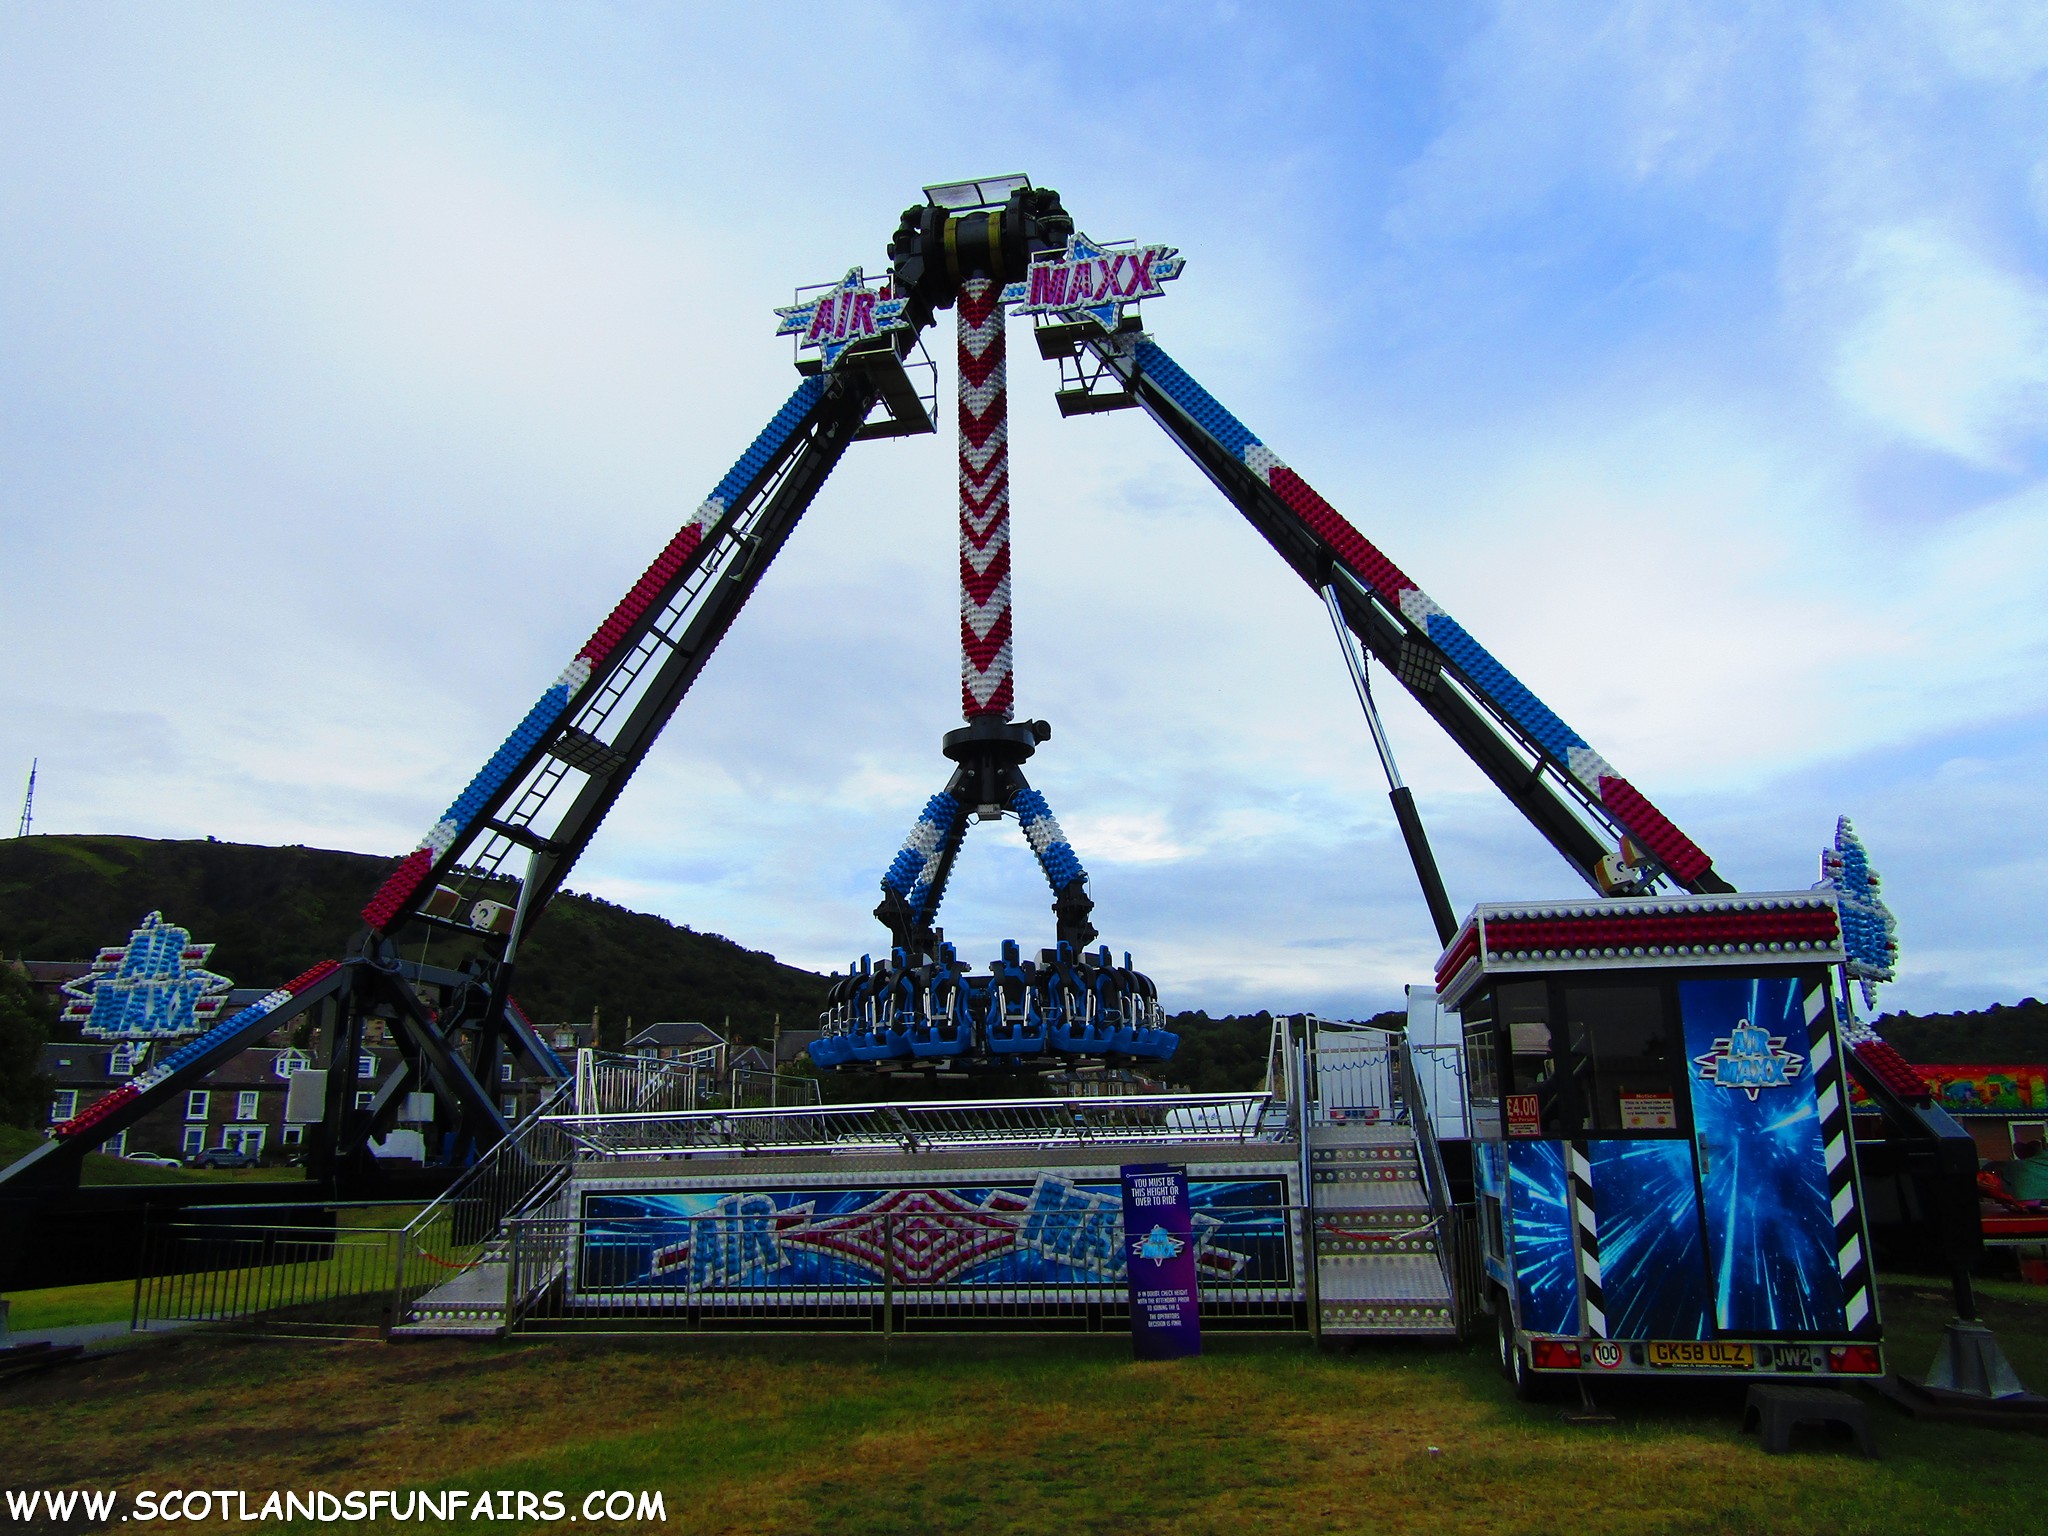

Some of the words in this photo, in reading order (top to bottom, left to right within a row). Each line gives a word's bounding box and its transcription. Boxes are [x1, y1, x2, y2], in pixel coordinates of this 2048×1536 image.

[1028, 249, 1156, 307] MAXX
[808, 291, 876, 340] AIR
[119, 928, 186, 980] AIR
[88, 983, 203, 1032] MAXX
[1730, 1027, 1771, 1057] AIR
[1716, 1057, 1787, 1084] MAXX
[1506, 1097, 1537, 1117] £4.00
[1132, 1188, 1146, 1198] THIS
[1146, 1186, 1168, 1196] HEIGHT
[1170, 1186, 1179, 1196] OR
[1134, 1178, 1147, 1188] YOU
[1148, 1177, 1166, 1187] MUST
[1166, 1176, 1175, 1186] BE
[1135, 1196, 1152, 1206] OVER
[1152, 1196, 1161, 1206] TO
[1162, 1195, 1176, 1205] RIDE
[690, 1192, 784, 1285] AIR
[1596, 1345, 1618, 1361] 100
[1657, 1342, 1704, 1361] GK58
[1710, 1342, 1745, 1361] ULZ
[1775, 1347, 1812, 1367] JW2
